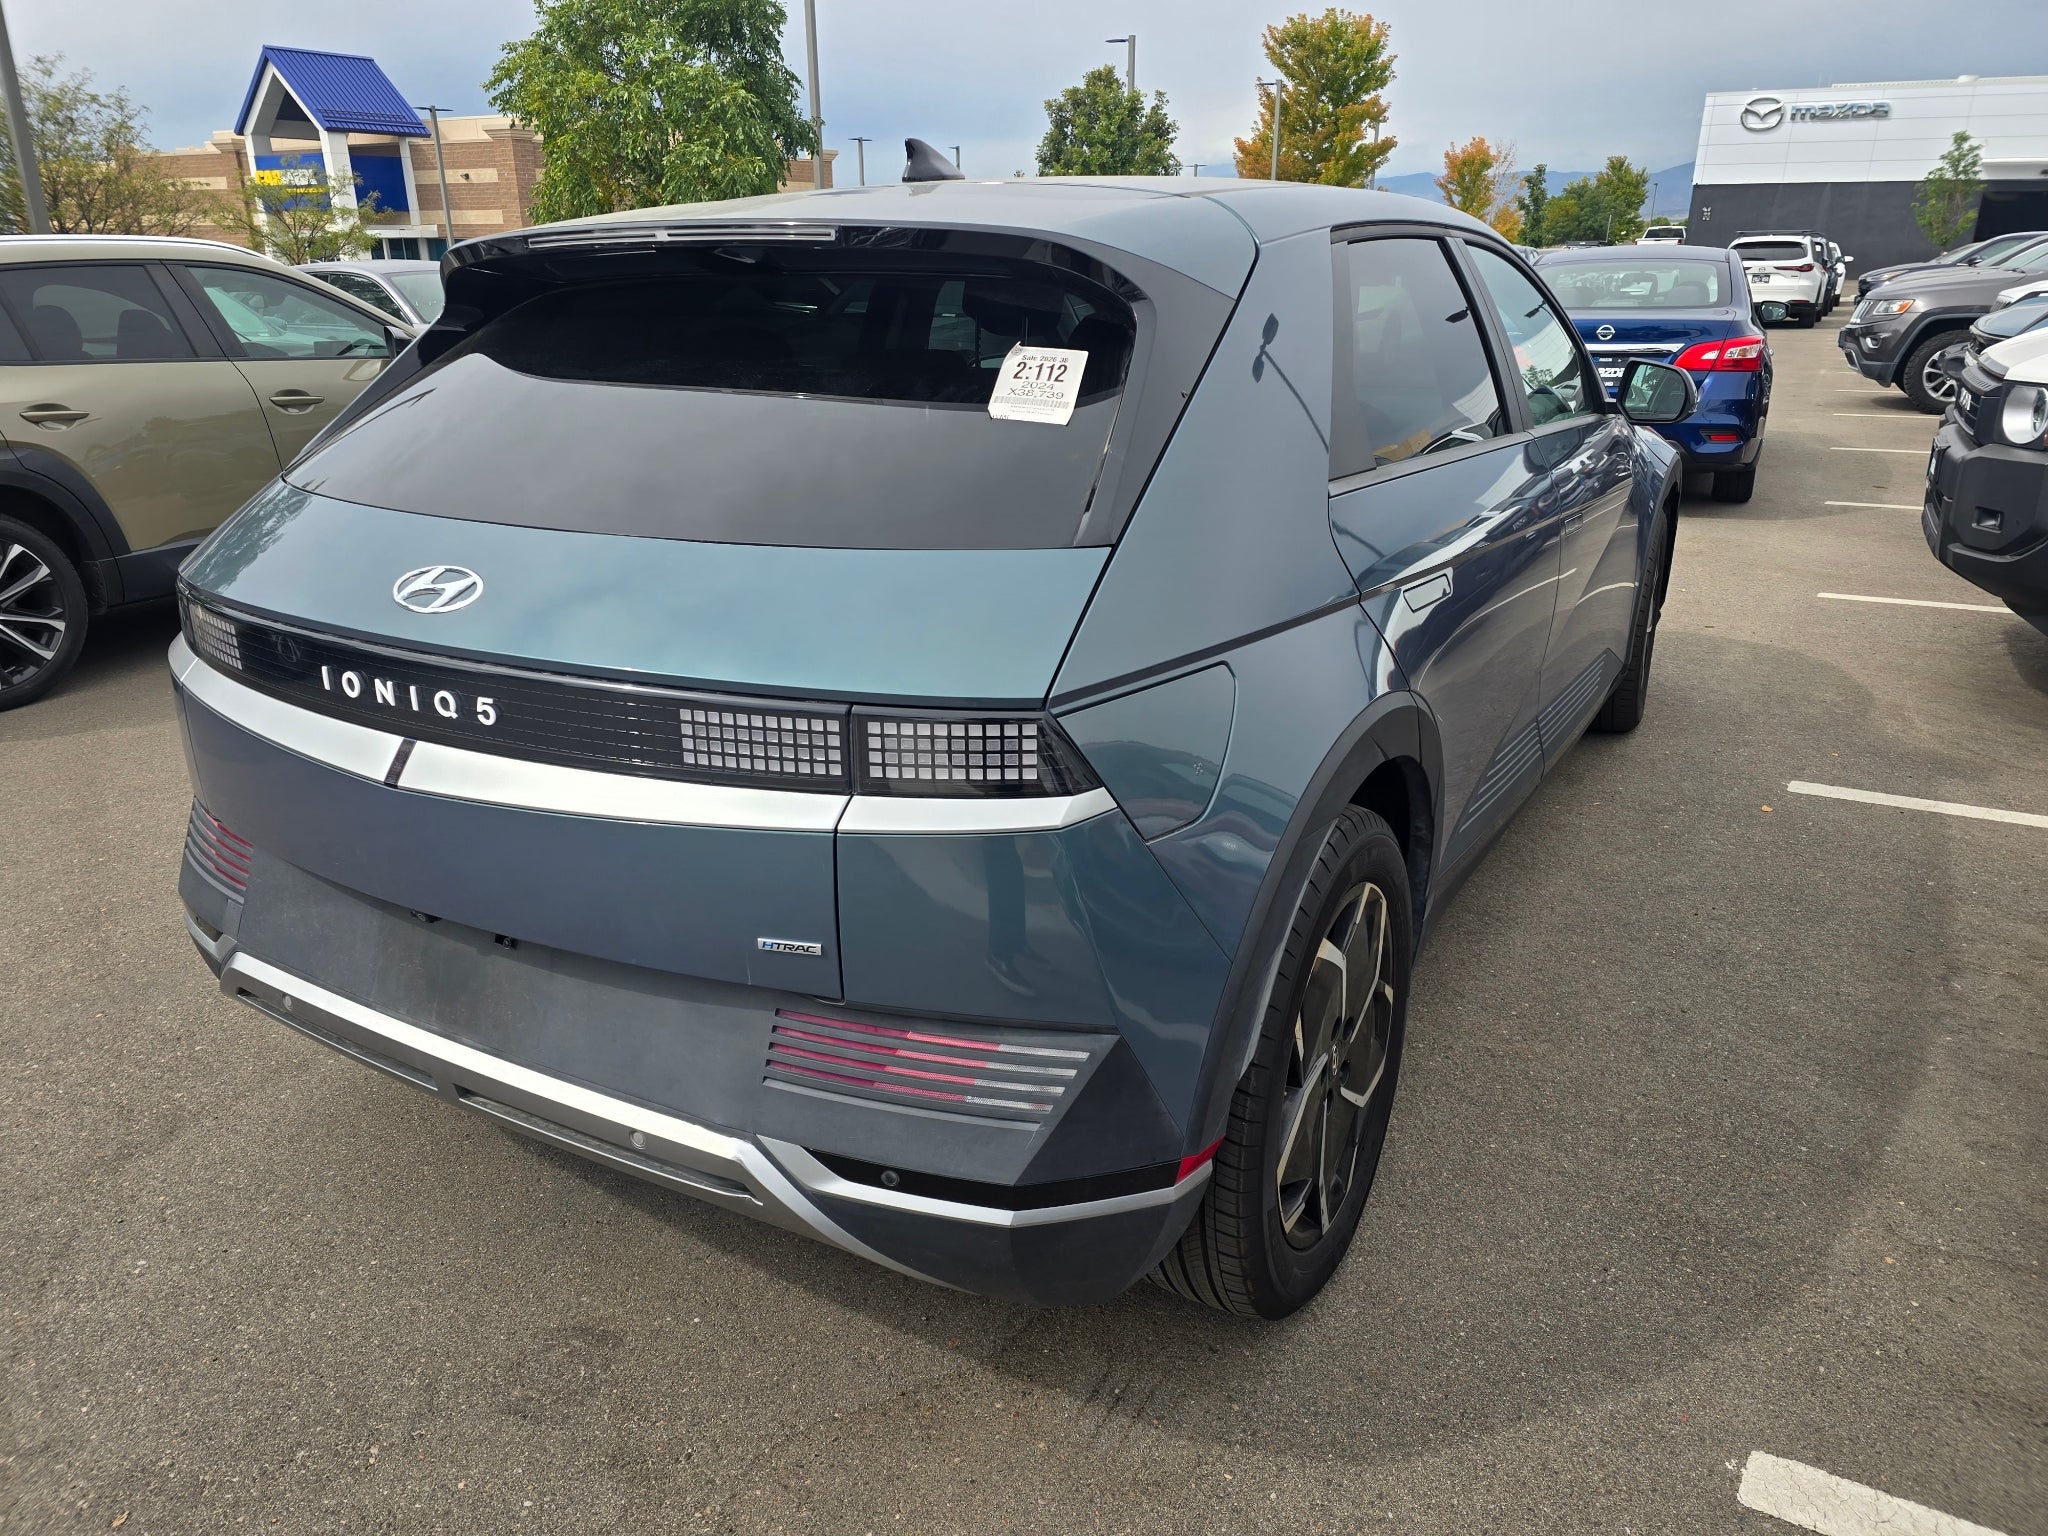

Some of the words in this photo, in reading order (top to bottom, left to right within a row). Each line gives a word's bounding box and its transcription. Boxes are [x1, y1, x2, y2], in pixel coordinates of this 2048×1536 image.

[1012, 361, 1068, 383] 2:112
[1021, 380, 1054, 390] 2024
[321, 665, 459, 720] IONIQ
[476, 696, 497, 726] 5
[761, 941, 817, 954] HTRAC
